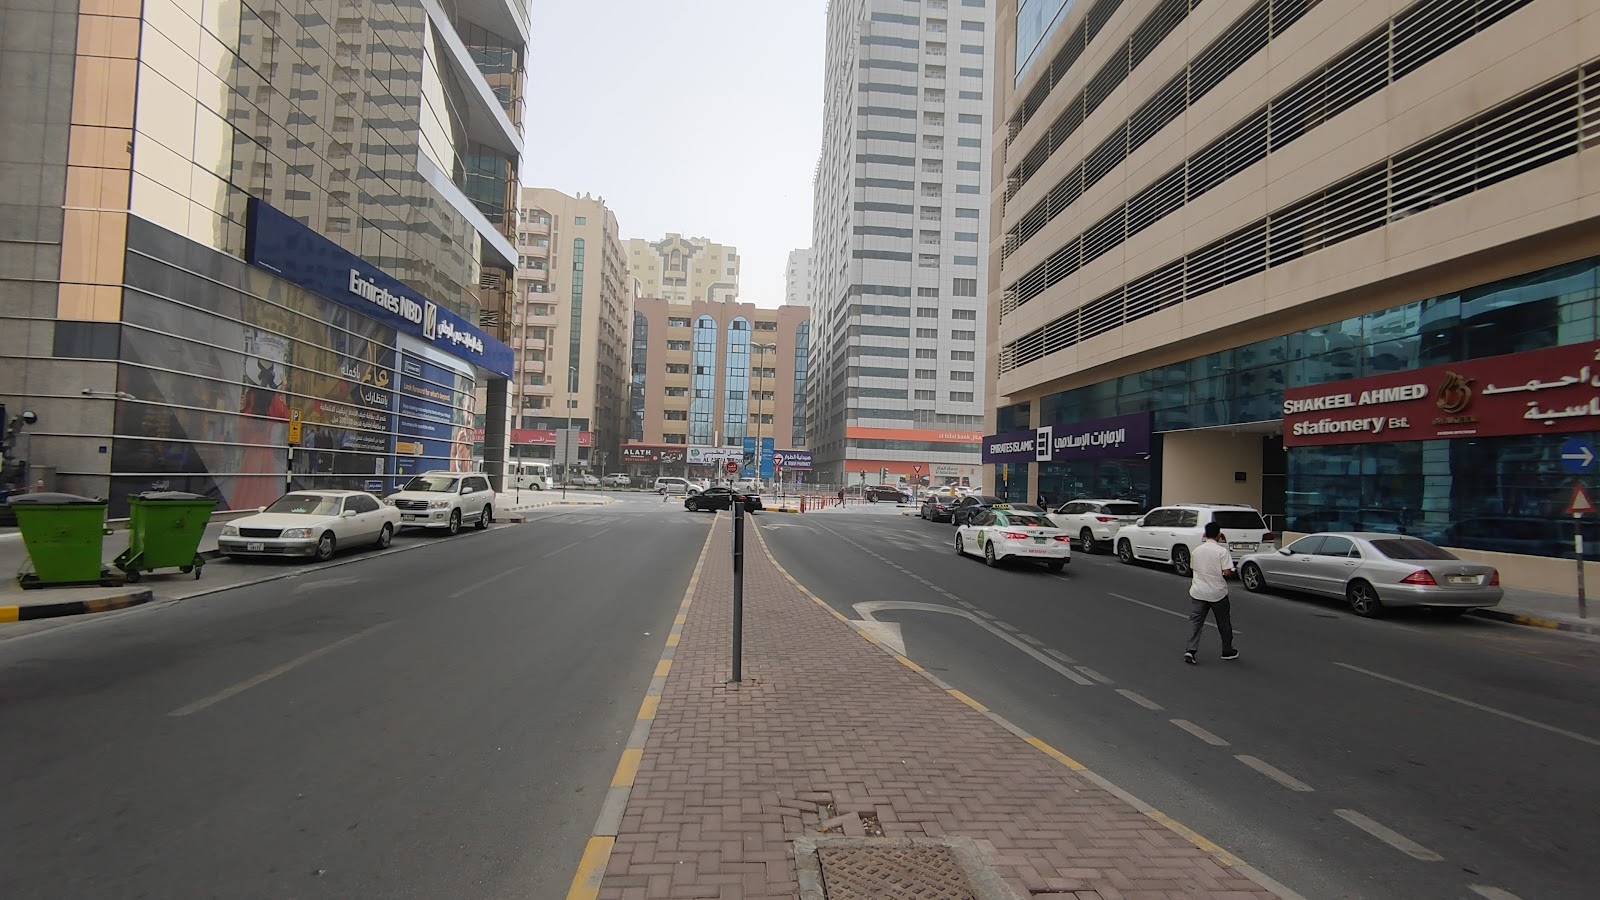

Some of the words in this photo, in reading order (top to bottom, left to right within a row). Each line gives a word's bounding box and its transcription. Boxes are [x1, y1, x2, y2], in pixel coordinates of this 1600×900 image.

[349, 268, 400, 314] Emirates
[400, 296, 423, 324] NBD
[1283, 393, 1357, 415] SHAKEEL
[1358, 383, 1428, 405] AHMED
[990, 441, 1013, 455] EMIRATES
[1012, 439, 1035, 453] ISLAMIC
[1054, 433, 1090, 453] الإسلامي
[1091, 428, 1125, 449] الإمارات
